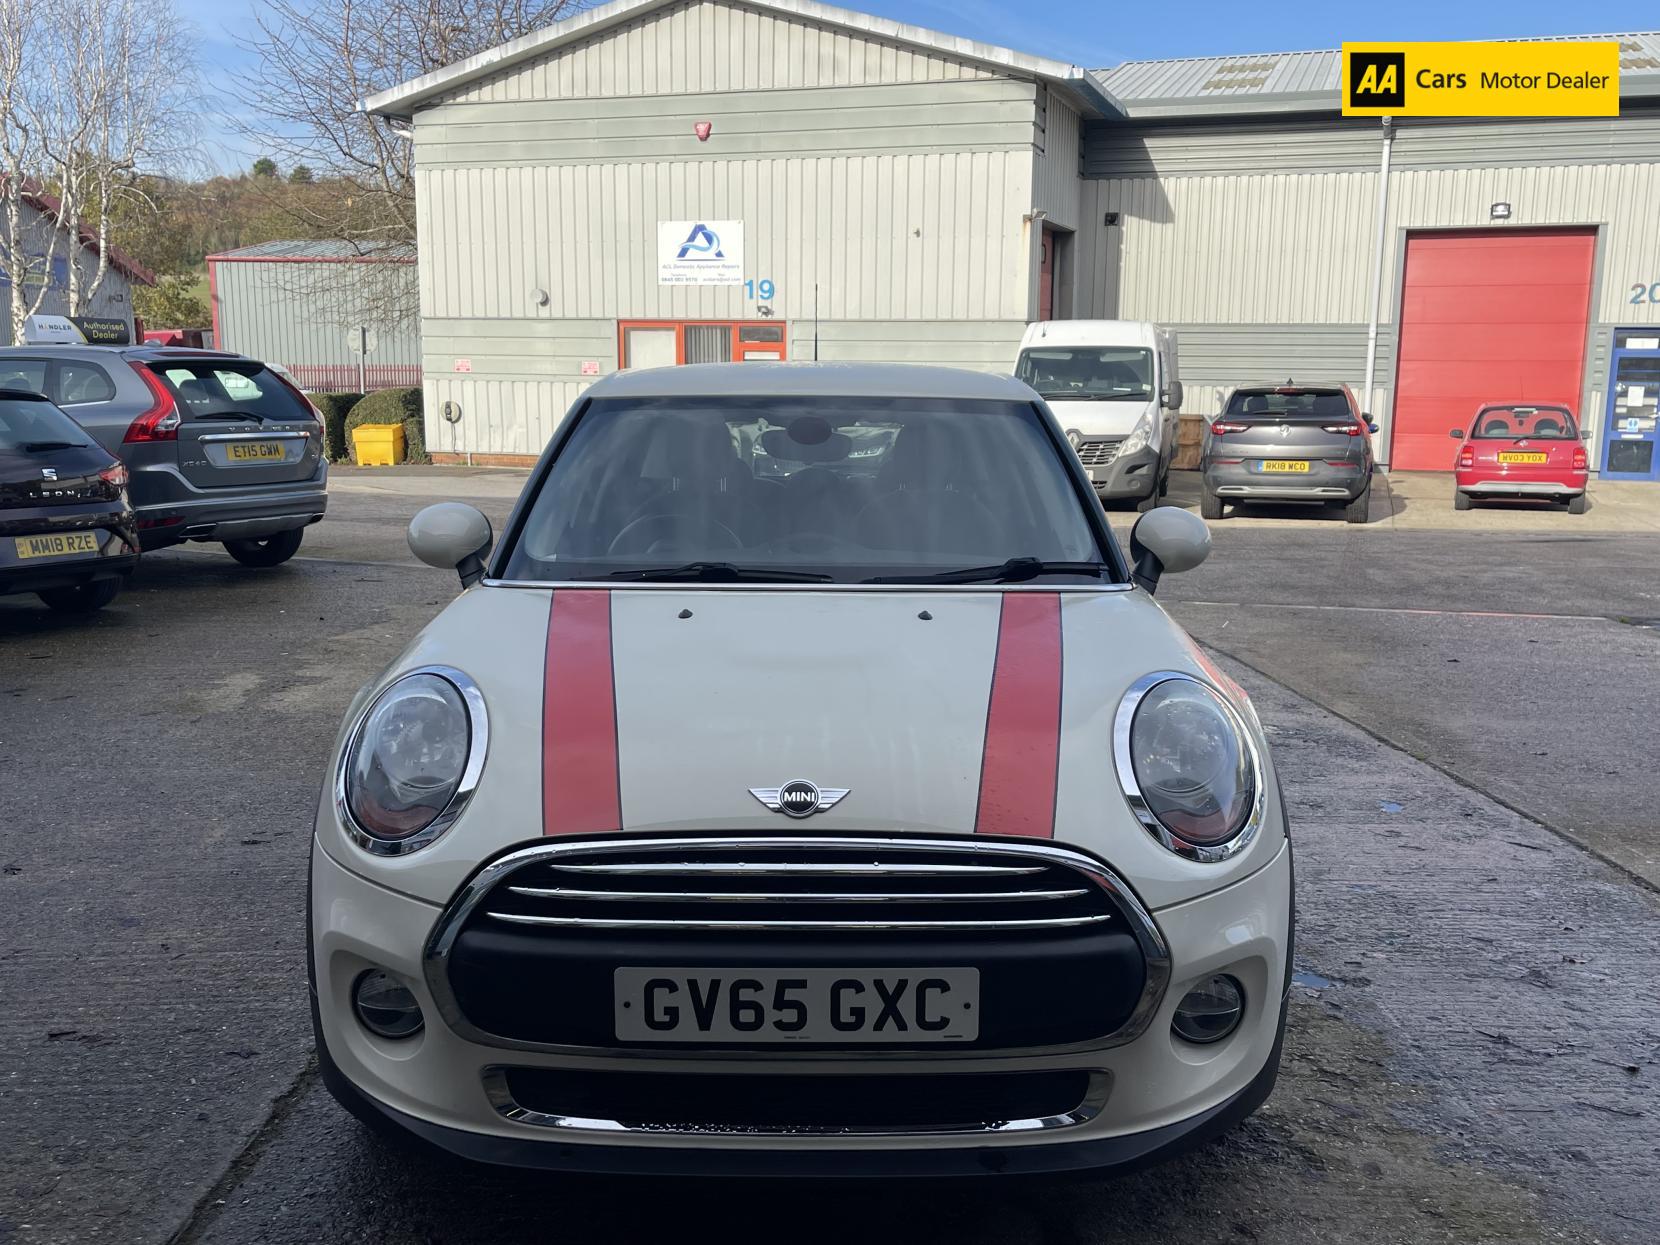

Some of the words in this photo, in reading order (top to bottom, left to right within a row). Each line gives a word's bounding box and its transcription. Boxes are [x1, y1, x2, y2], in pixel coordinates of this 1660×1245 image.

[744, 279, 775, 300] 19
[83, 321, 125, 331] Authorised
[92, 329, 118, 339] Dealer
[233, 444, 258, 458] ET15
[1265, 462, 1286, 471] RK18
[29, 537, 64, 555] MM18
[66, 535, 94, 551] RZE
[783, 790, 816, 803] MINI
[643, 977, 808, 1032] GV65
[829, 977, 951, 1032] GXC
